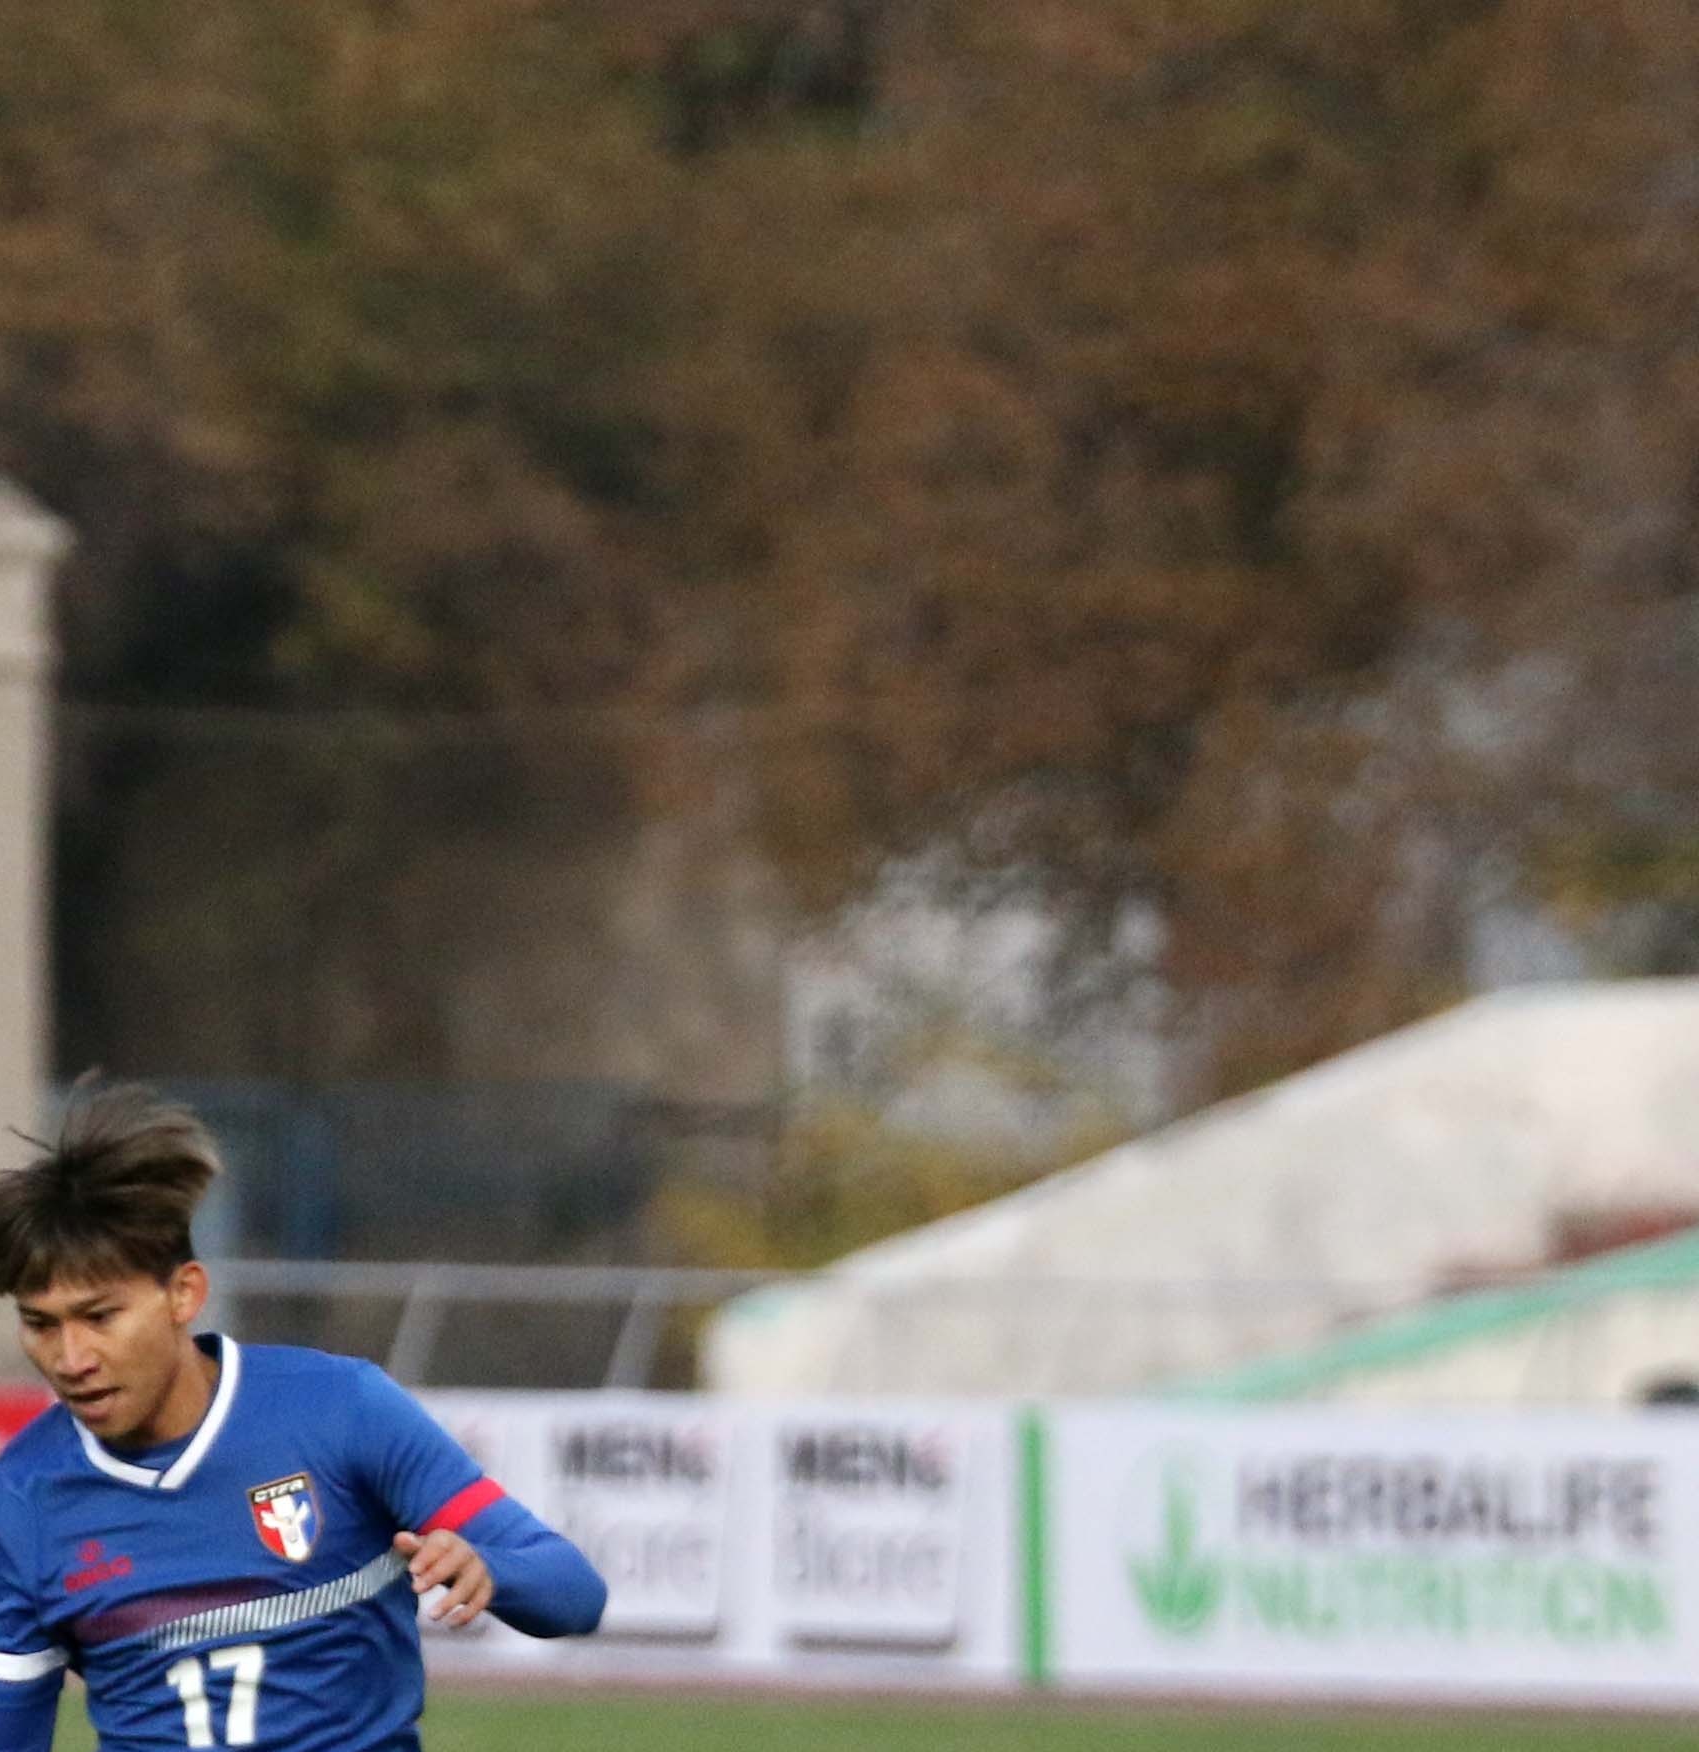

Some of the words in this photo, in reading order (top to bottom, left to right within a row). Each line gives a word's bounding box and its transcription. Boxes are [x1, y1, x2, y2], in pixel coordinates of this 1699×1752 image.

[1237, 1456, 1663, 1552] HERBALIFE
[1237, 1552, 1671, 1643] NUTRITION
[165, 1644, 265, 1749] 17
